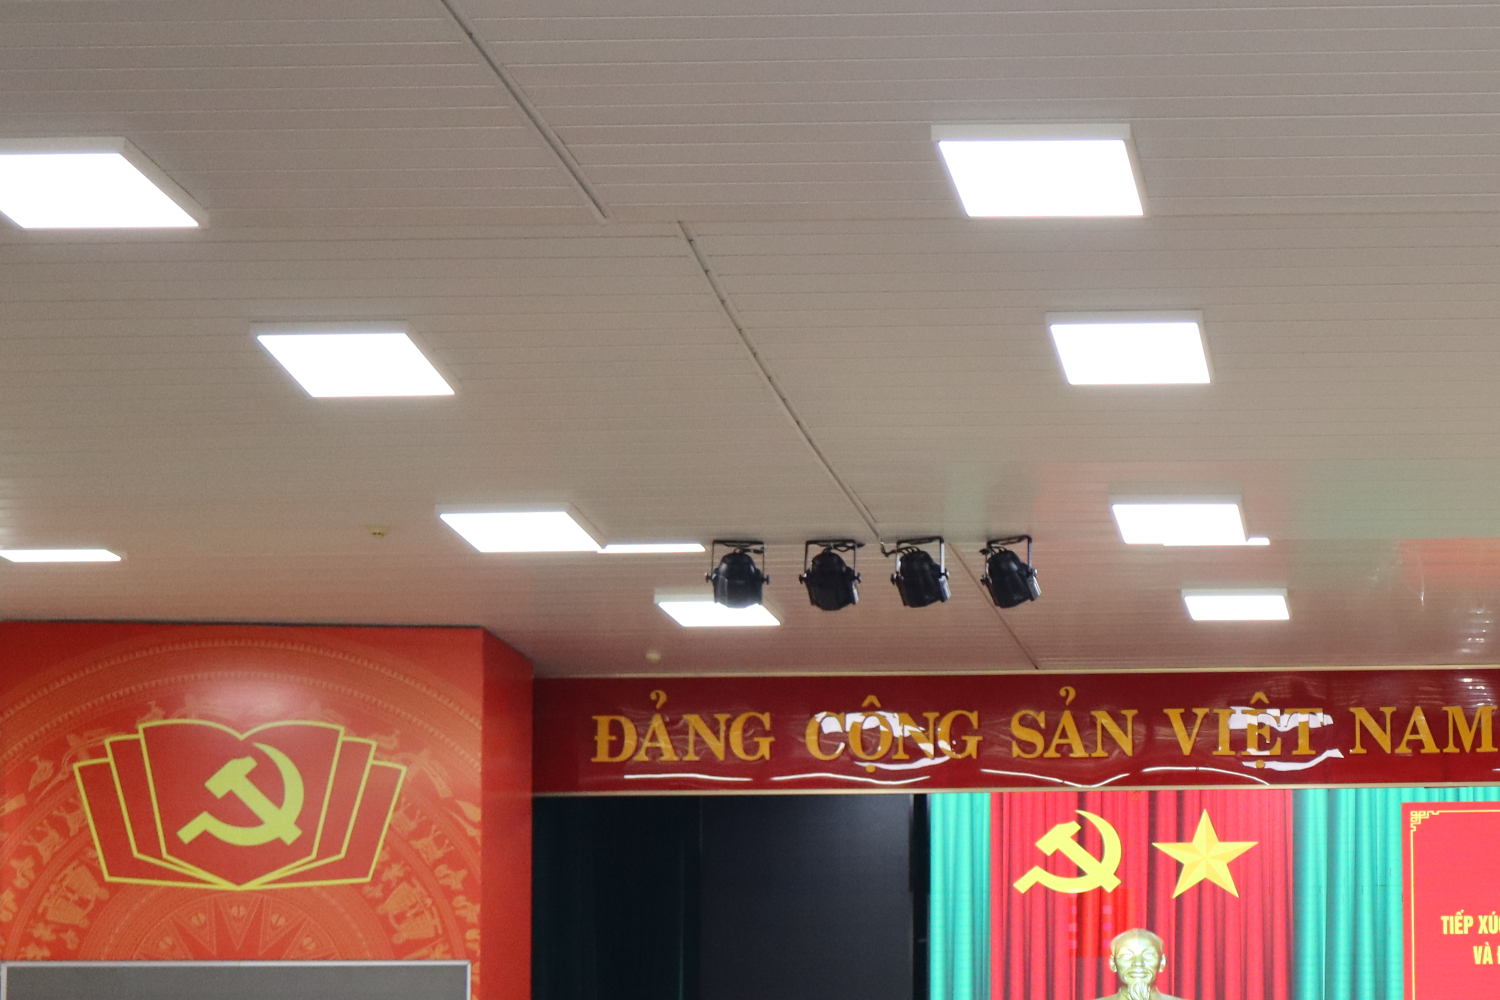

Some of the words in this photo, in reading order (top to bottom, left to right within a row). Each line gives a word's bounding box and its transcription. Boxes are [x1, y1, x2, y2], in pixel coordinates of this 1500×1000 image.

[591, 690, 775, 763] ĐẢNG
[805, 695, 983, 773] CỘNG
[1011, 686, 1138, 758] SẢN
[1163, 692, 1324, 769] VIỆT
[1349, 705, 1498, 756] NAM
[1440, 909, 1474, 935] TIẾP
[1473, 942, 1494, 965] VÀ
